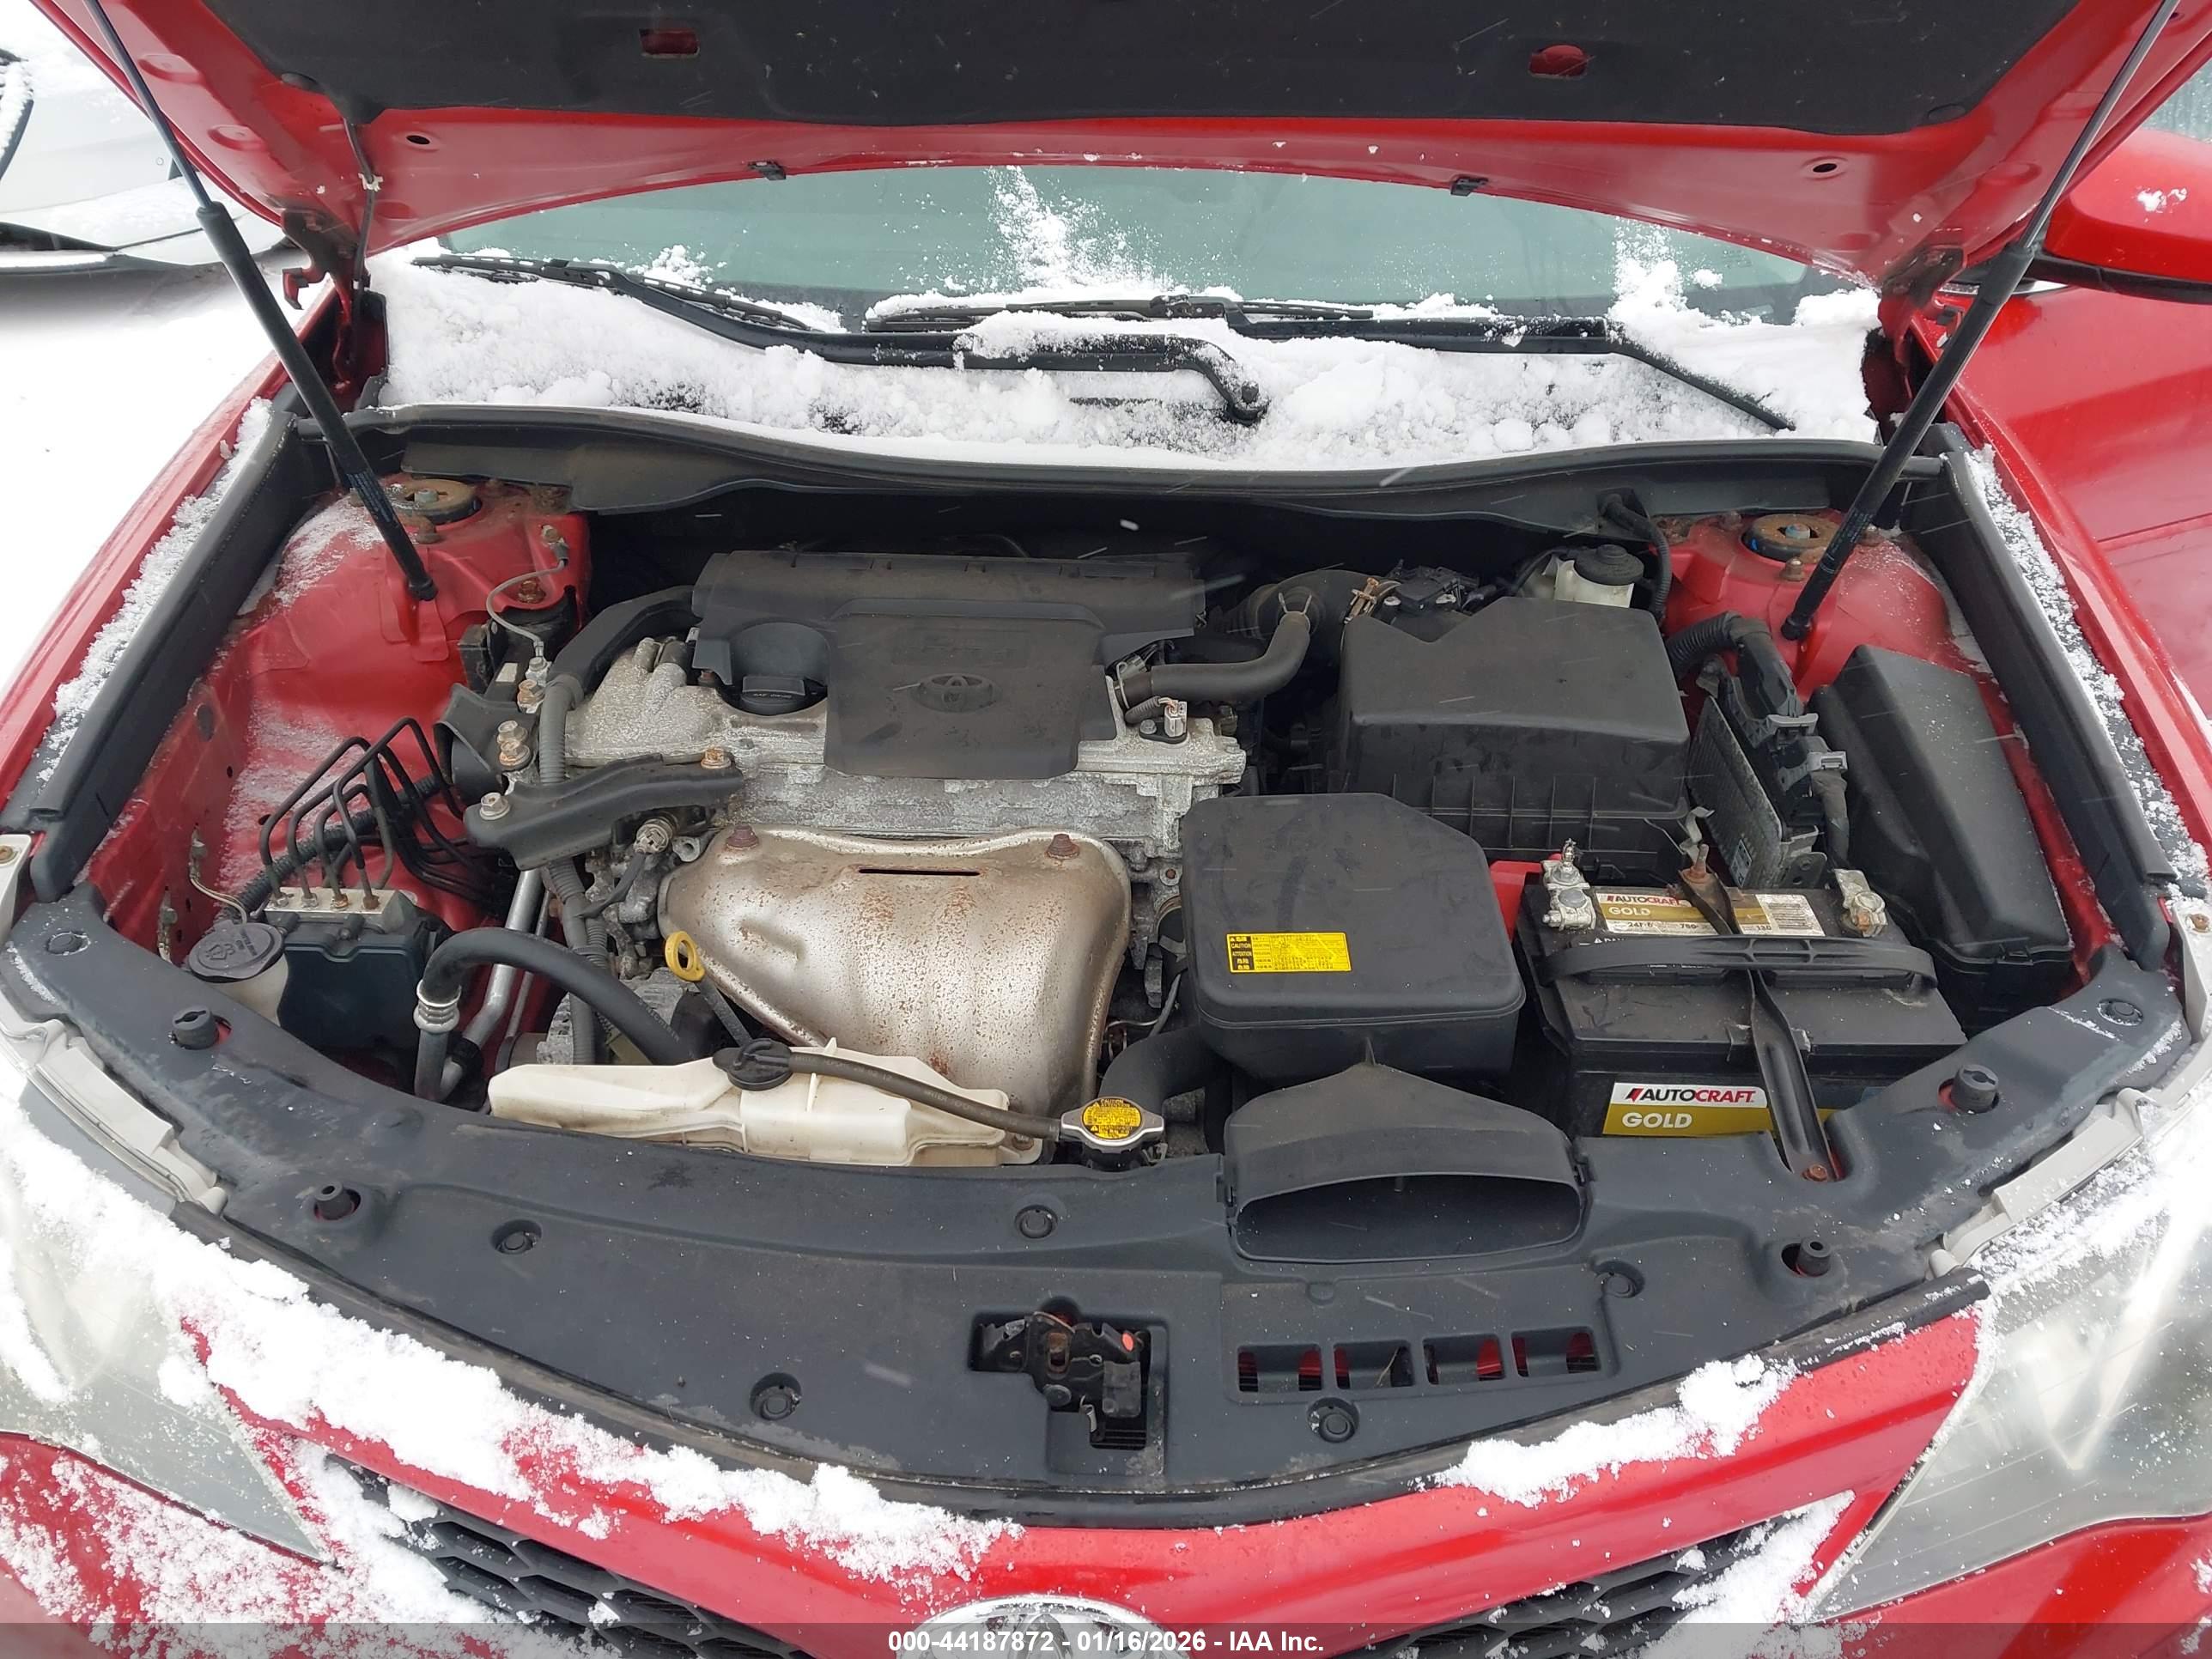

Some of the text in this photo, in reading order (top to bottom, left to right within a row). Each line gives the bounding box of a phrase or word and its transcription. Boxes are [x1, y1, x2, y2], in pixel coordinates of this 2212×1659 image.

[1615, 895, 1680, 906] AUTOCRAFT
[1608, 906, 1650, 916] GOLD
[1639, 1088, 1756, 1103] AUTOCRAFT
[1621, 1112, 1692, 1128] GOLD
